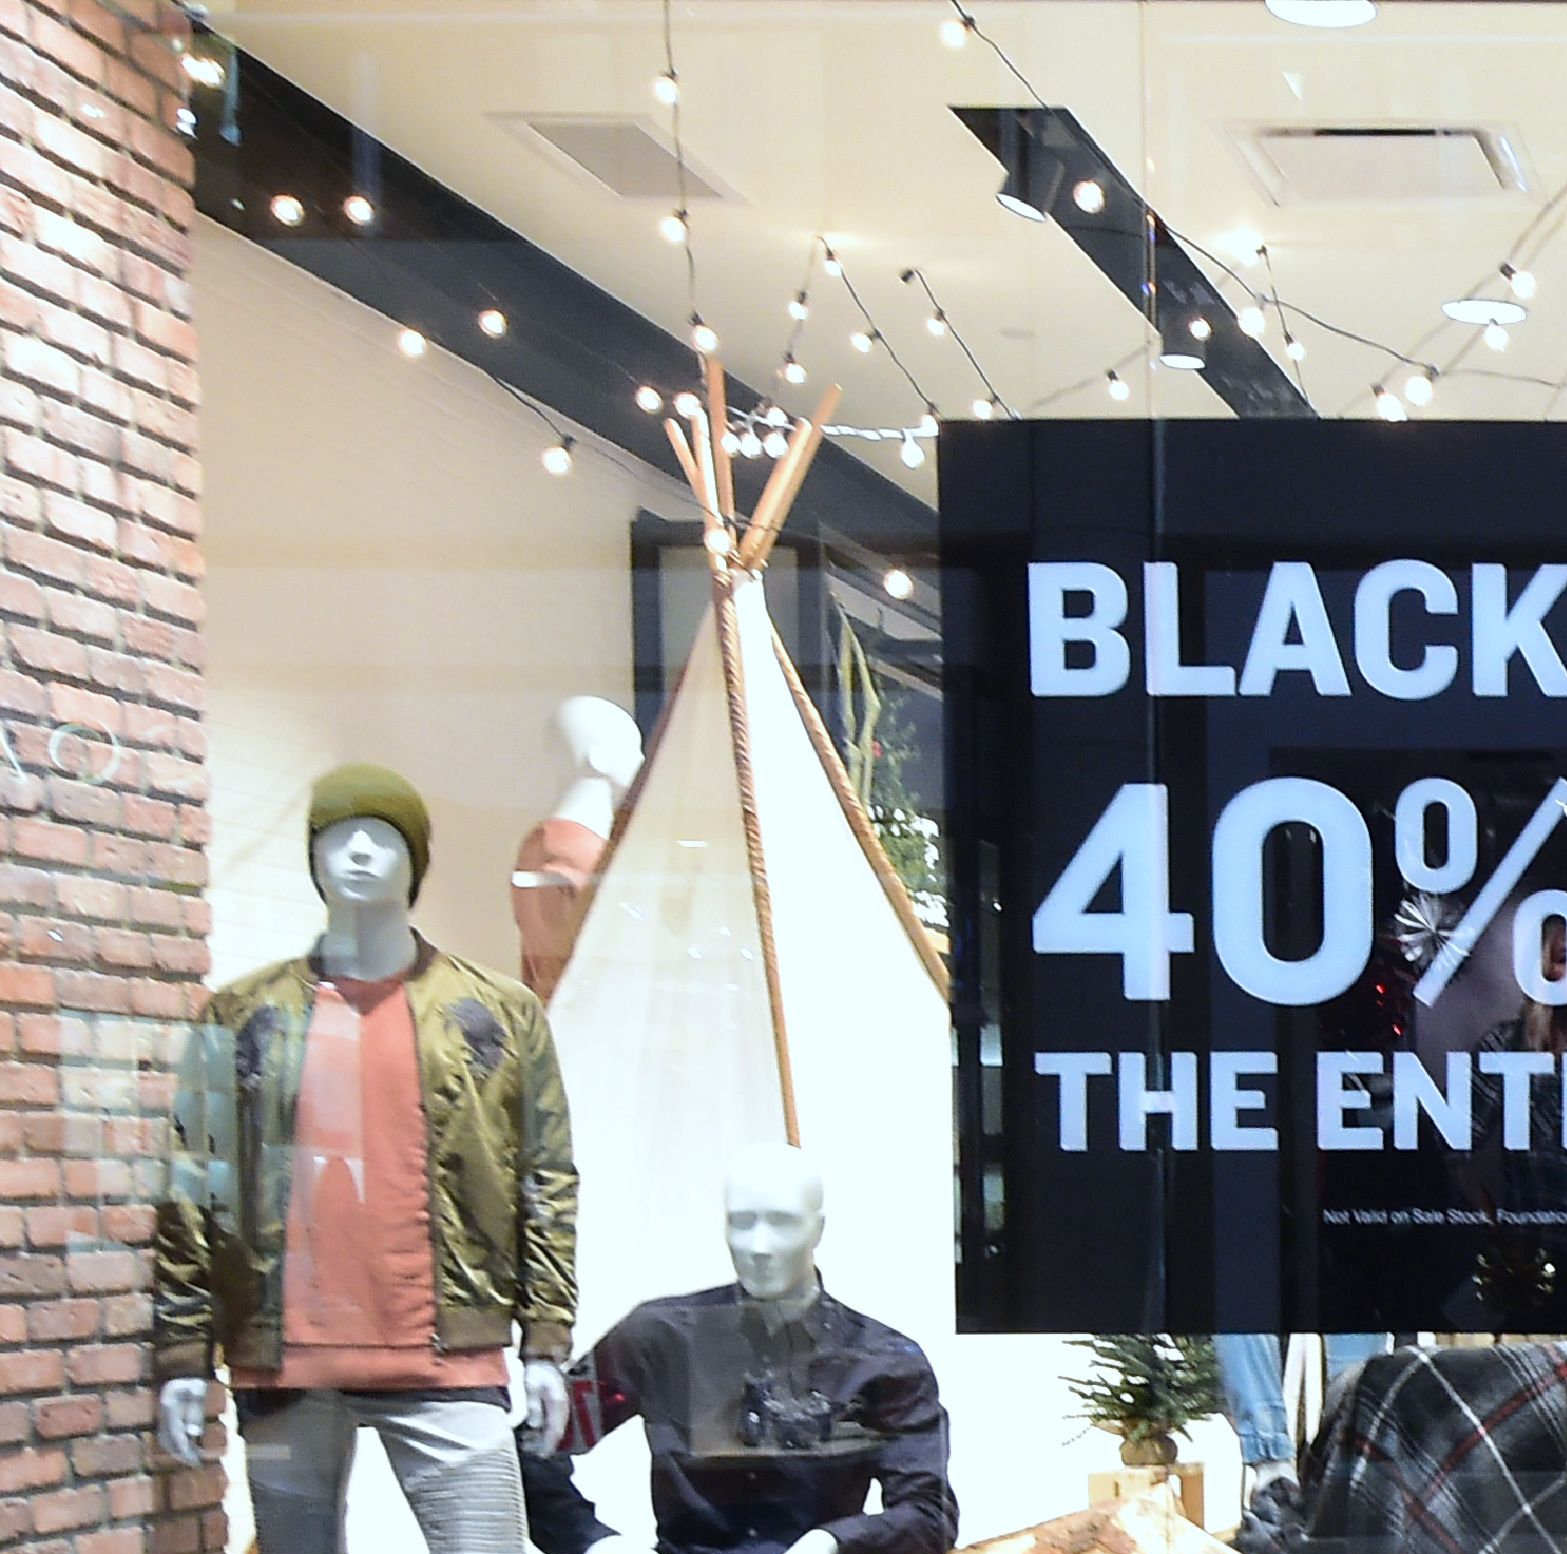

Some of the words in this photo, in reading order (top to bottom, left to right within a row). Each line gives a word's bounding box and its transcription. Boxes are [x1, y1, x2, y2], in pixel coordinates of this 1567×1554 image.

[1034, 1050, 1279, 1152] THE
[1323, 1207, 1349, 1225] Not
[1352, 1207, 1388, 1225] Valid
[1391, 1211, 1410, 1225] on
[1412, 1207, 1444, 1225] Sale
[1447, 1207, 1494, 1227] Stock,
